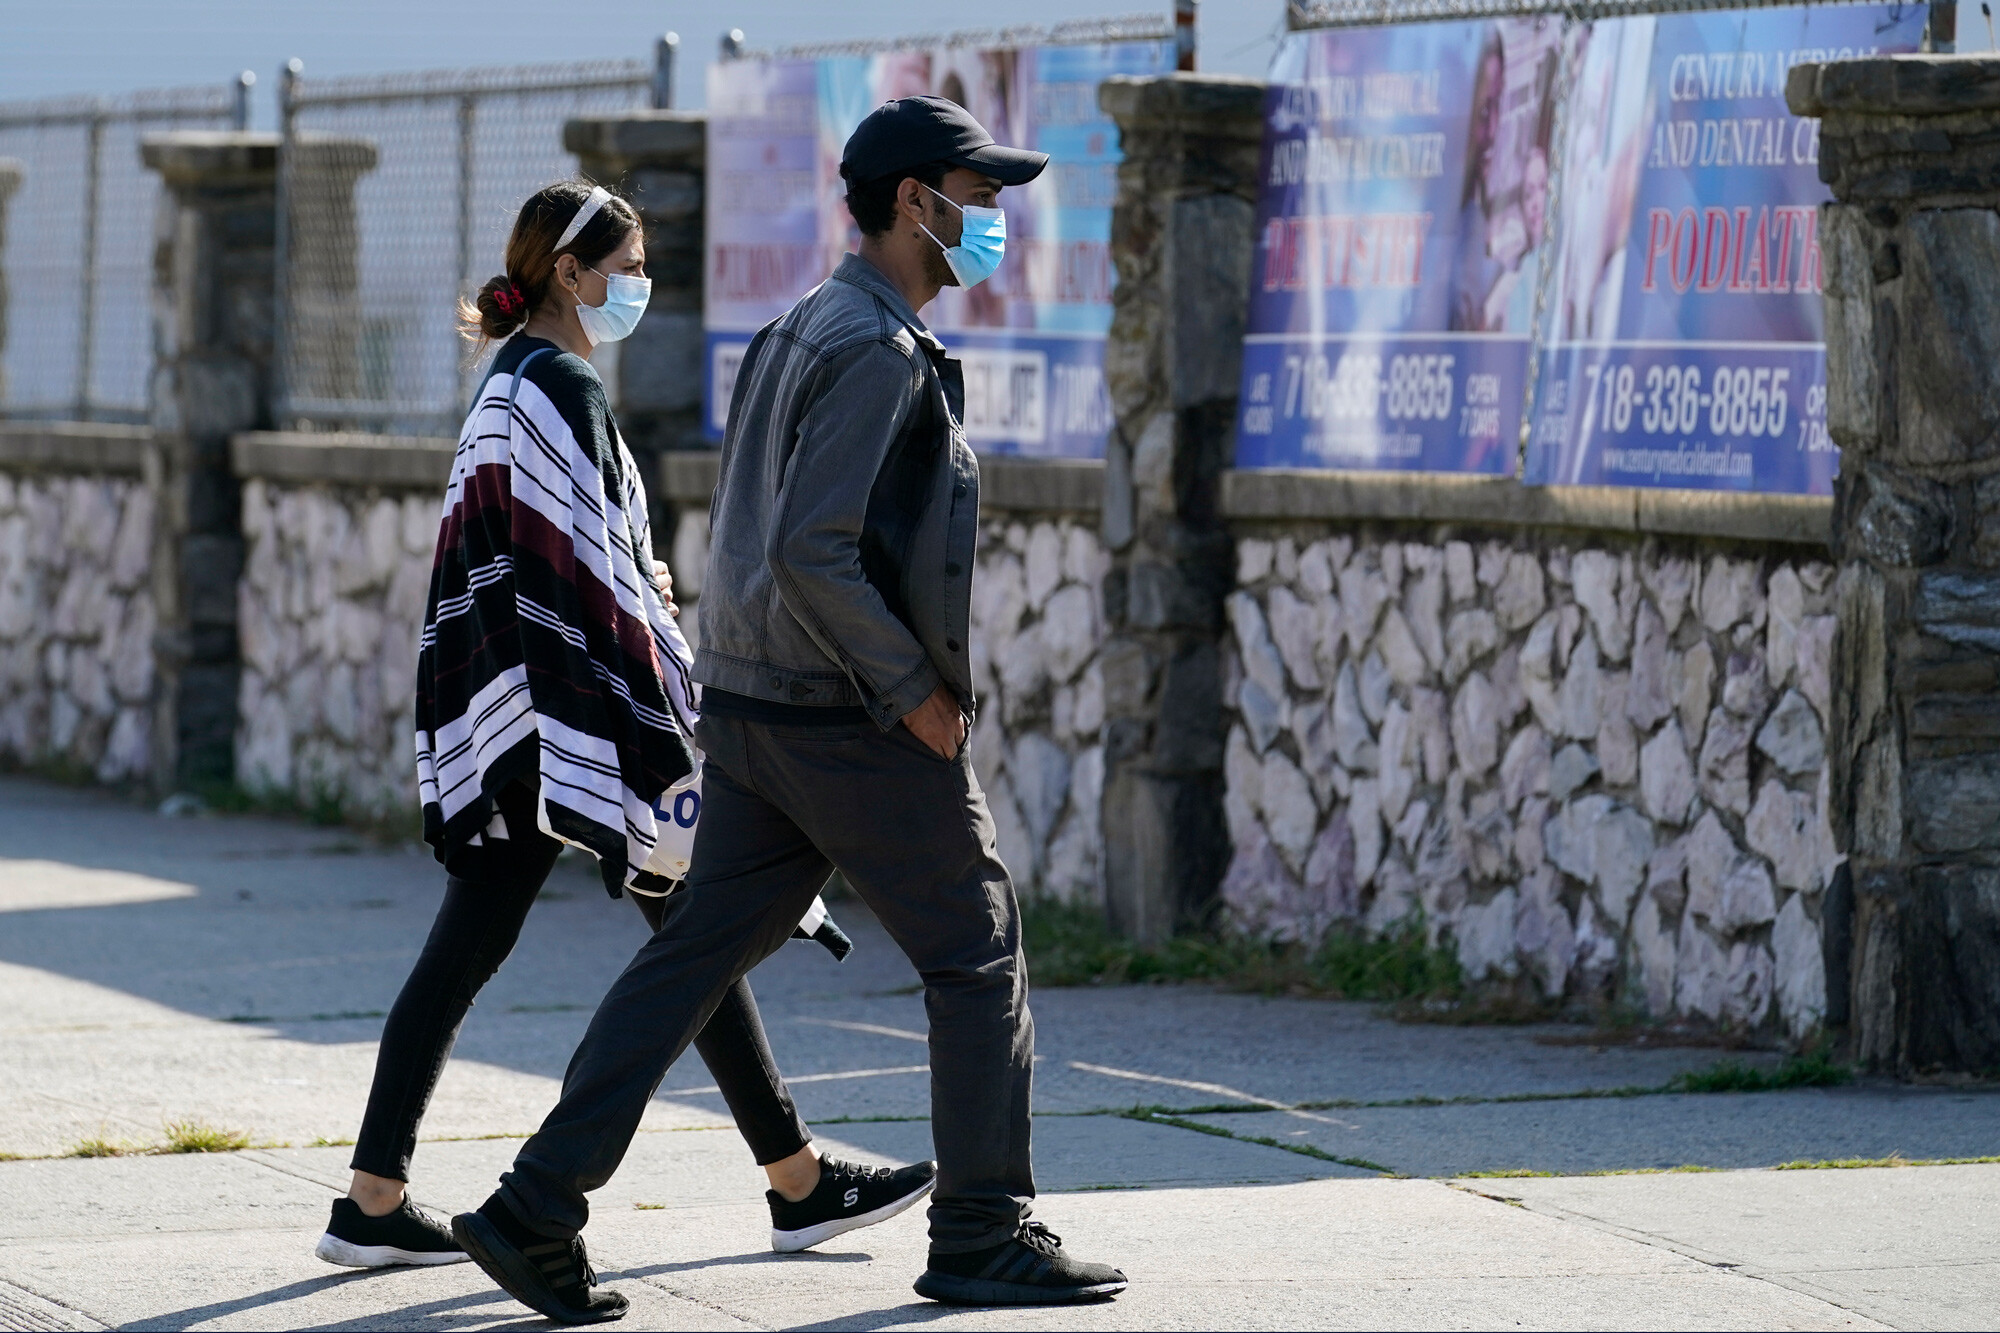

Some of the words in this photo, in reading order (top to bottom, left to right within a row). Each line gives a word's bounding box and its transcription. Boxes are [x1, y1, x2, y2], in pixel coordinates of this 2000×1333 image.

[1669, 51, 1768, 101] CENTURY
[1649, 119, 1698, 168] AND
[1700, 117, 1787, 167] DENTAL
[1641, 204, 1823, 295] PODIATR
[1582, 364, 1791, 438] 718-336-8855
[1805, 384, 1828, 417] OP
[1797, 420, 1809, 452] 7
[1808, 420, 1841, 454] DA
[1602, 441, 1754, 483] www.centurymedicaldental.com
[844, 1187, 859, 1208] S
